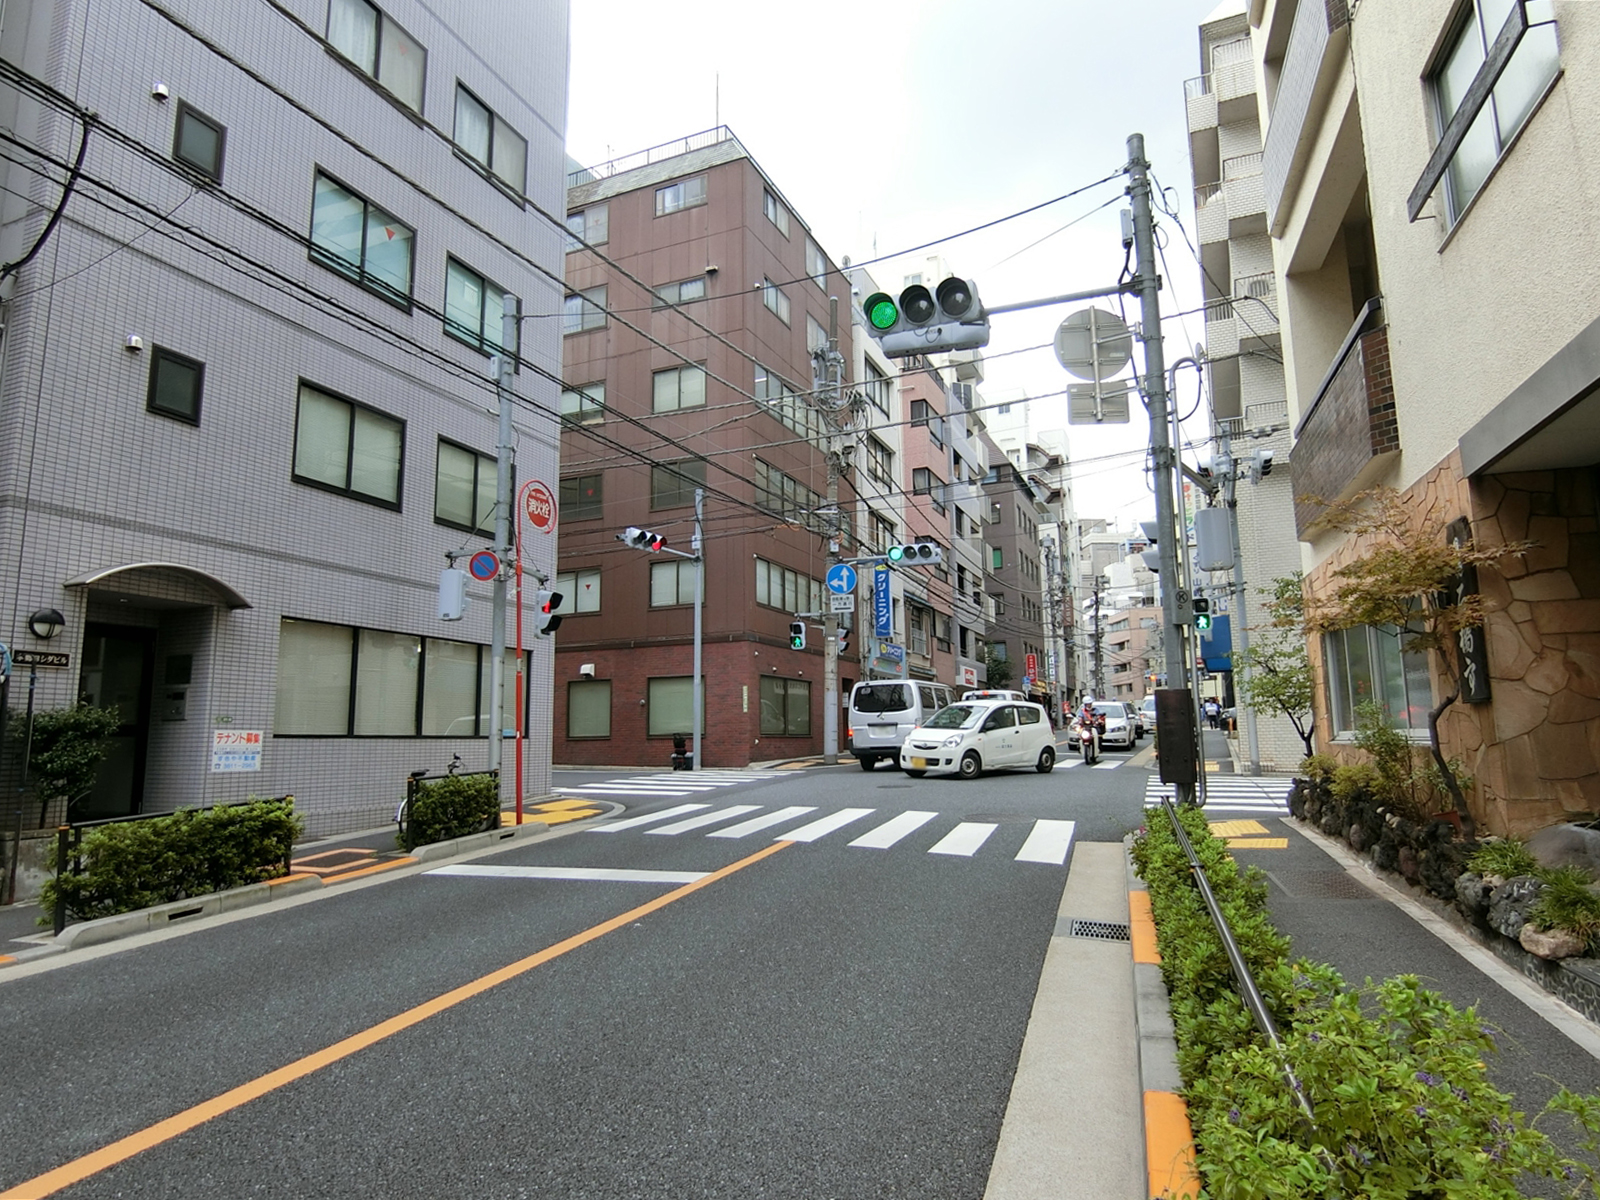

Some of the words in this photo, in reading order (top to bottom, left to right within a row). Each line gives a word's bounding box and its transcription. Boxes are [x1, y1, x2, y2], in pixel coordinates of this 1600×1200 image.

[528, 497, 550, 519] 消火栓
[877, 573, 889, 627] クリーニング
[216, 732, 260, 744] テナント募集
